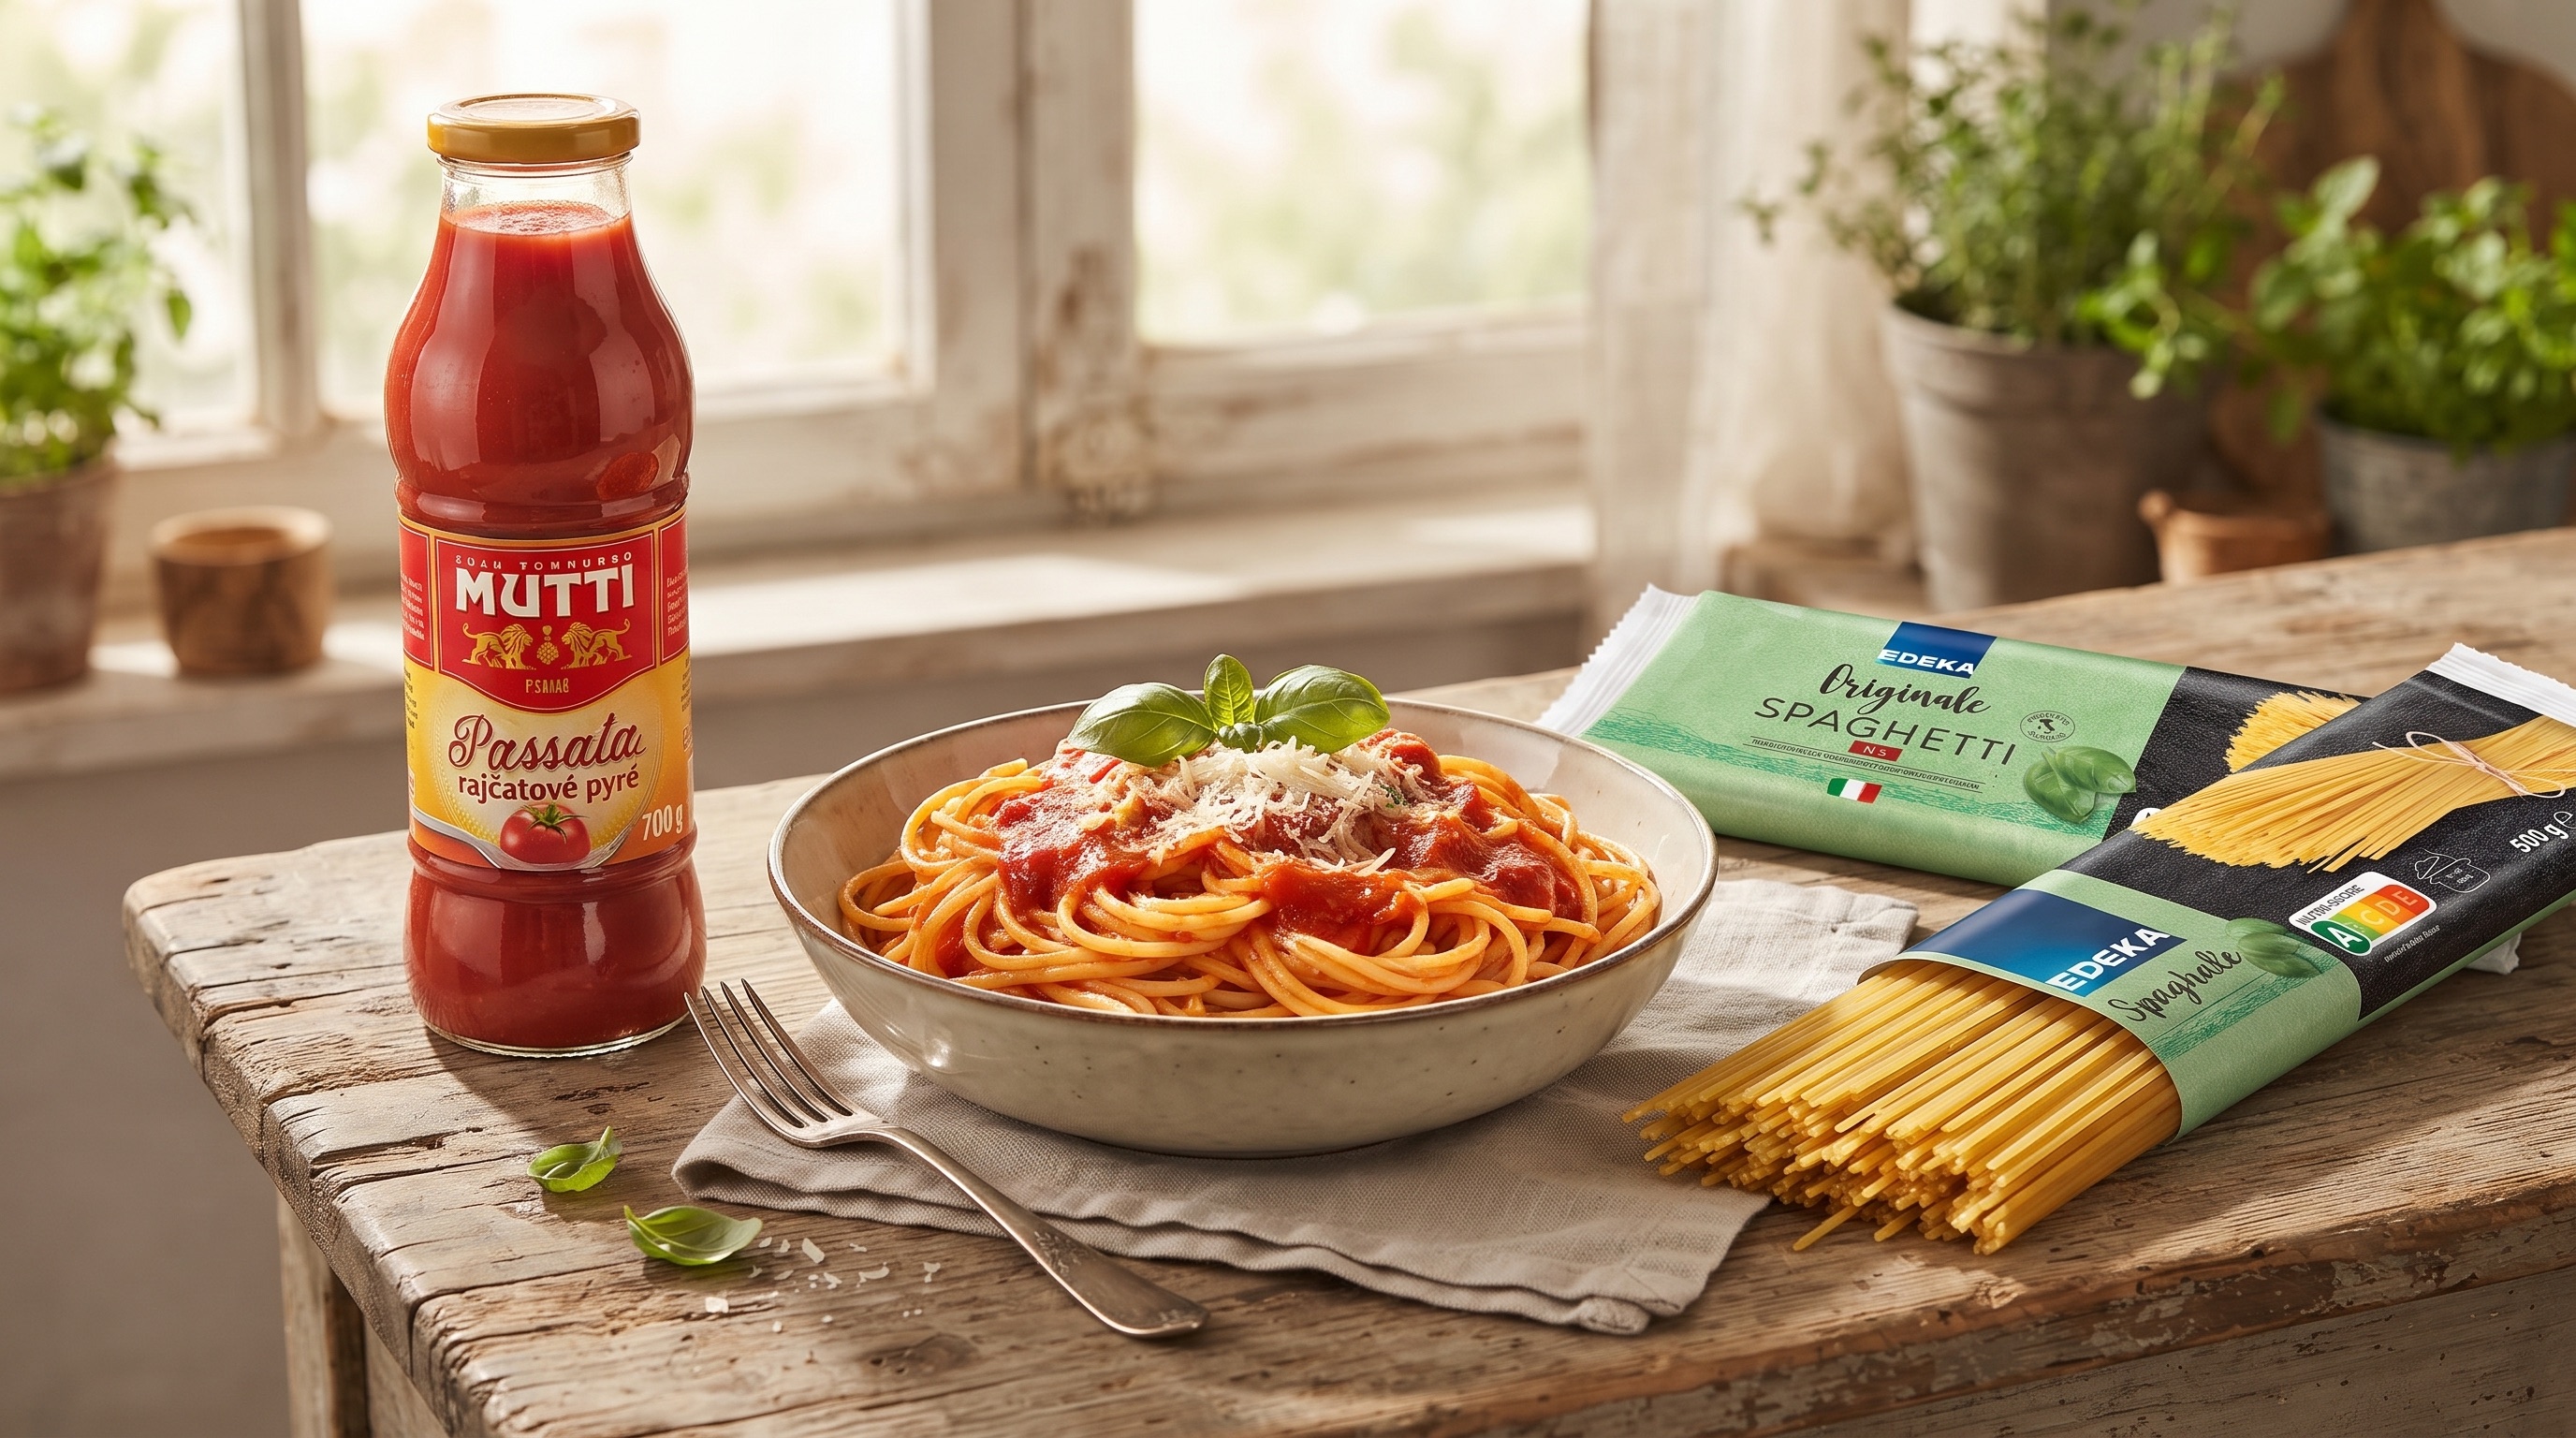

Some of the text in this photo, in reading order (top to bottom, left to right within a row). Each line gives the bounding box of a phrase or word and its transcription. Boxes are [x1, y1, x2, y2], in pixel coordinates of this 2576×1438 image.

[455, 564, 636, 618] MUTTI
[1877, 649, 1975, 675] EDEKA
[1820, 663, 1991, 715] Originale
[447, 712, 647, 771] Passata
[1754, 697, 2016, 766] SPAGHETTI
[459, 764, 639, 803] rajčatové pyré
[641, 803, 683, 841] 700 g
[2510, 829, 2549, 853] 500
[2543, 824, 2569, 840] g
[2327, 927, 2364, 948] A
[2360, 909, 2385, 925] C
[2374, 900, 2401, 917] D
[2392, 890, 2418, 906] E
[2044, 927, 2171, 992] EDEKA
